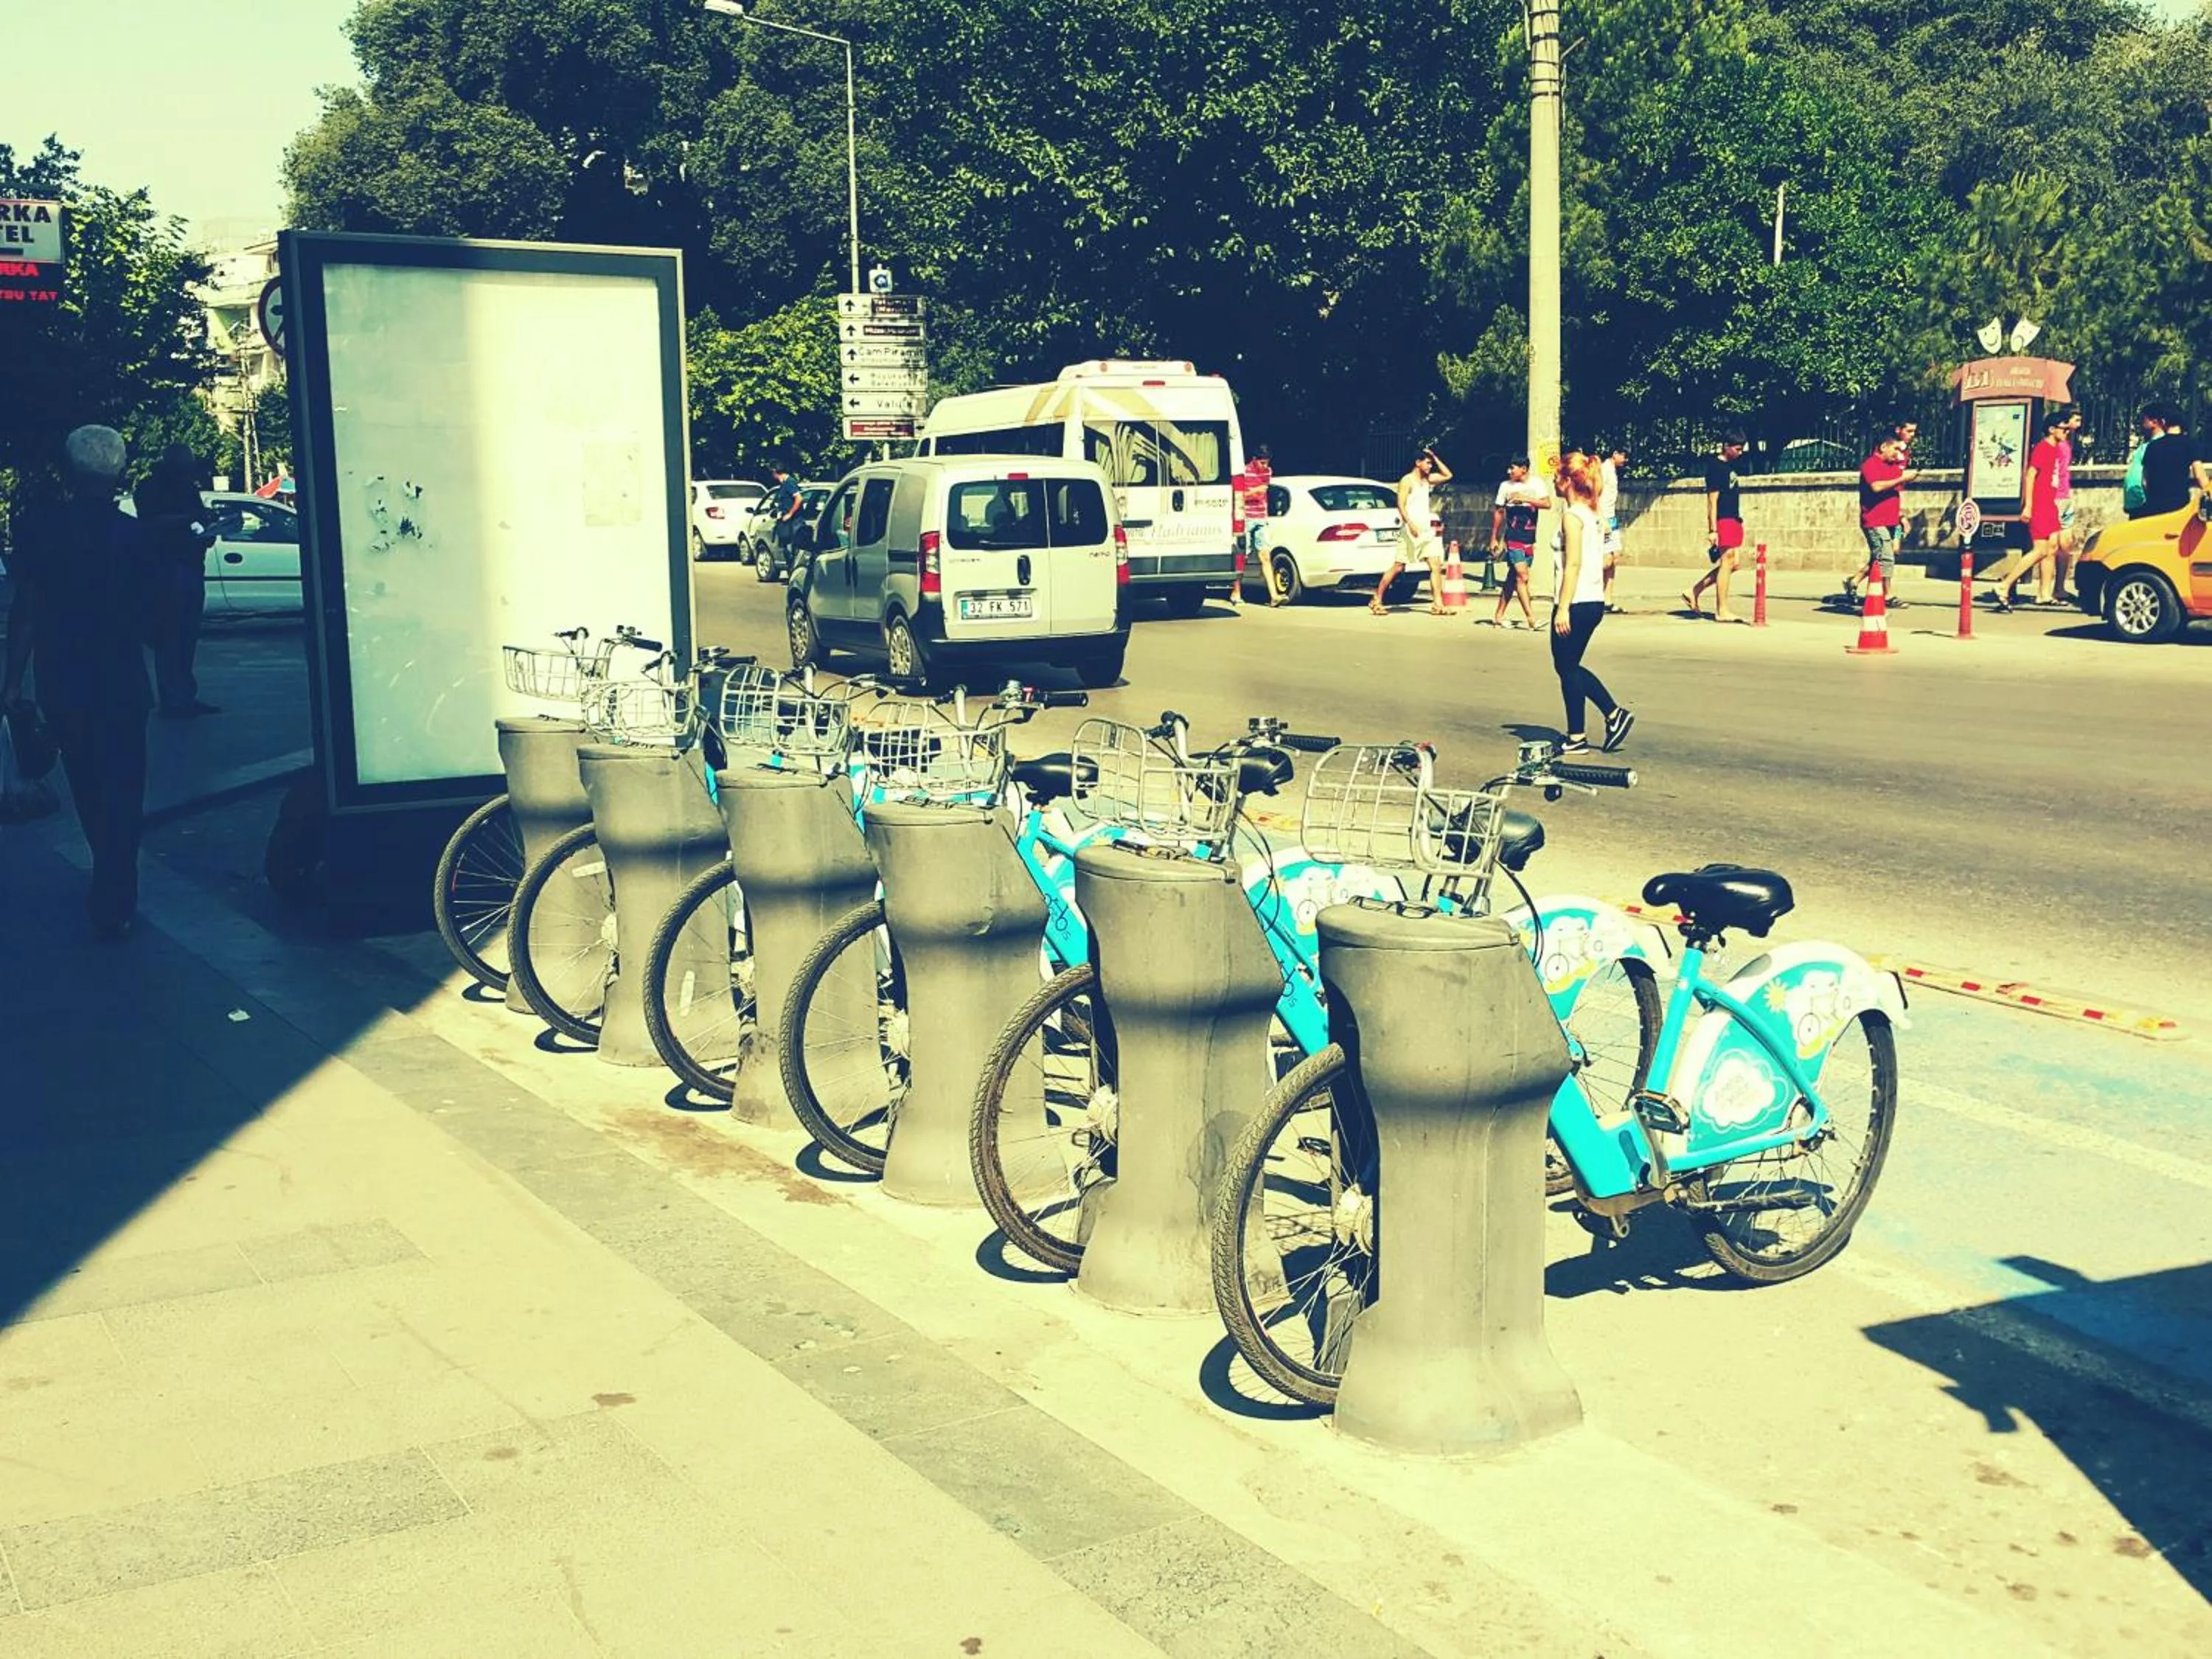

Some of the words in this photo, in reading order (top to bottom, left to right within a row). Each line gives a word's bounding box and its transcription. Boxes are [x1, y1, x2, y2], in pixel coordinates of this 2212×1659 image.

[0, 225, 35, 243] EL
[990, 601, 1003, 612] FK
[1009, 600, 1029, 613] 571
